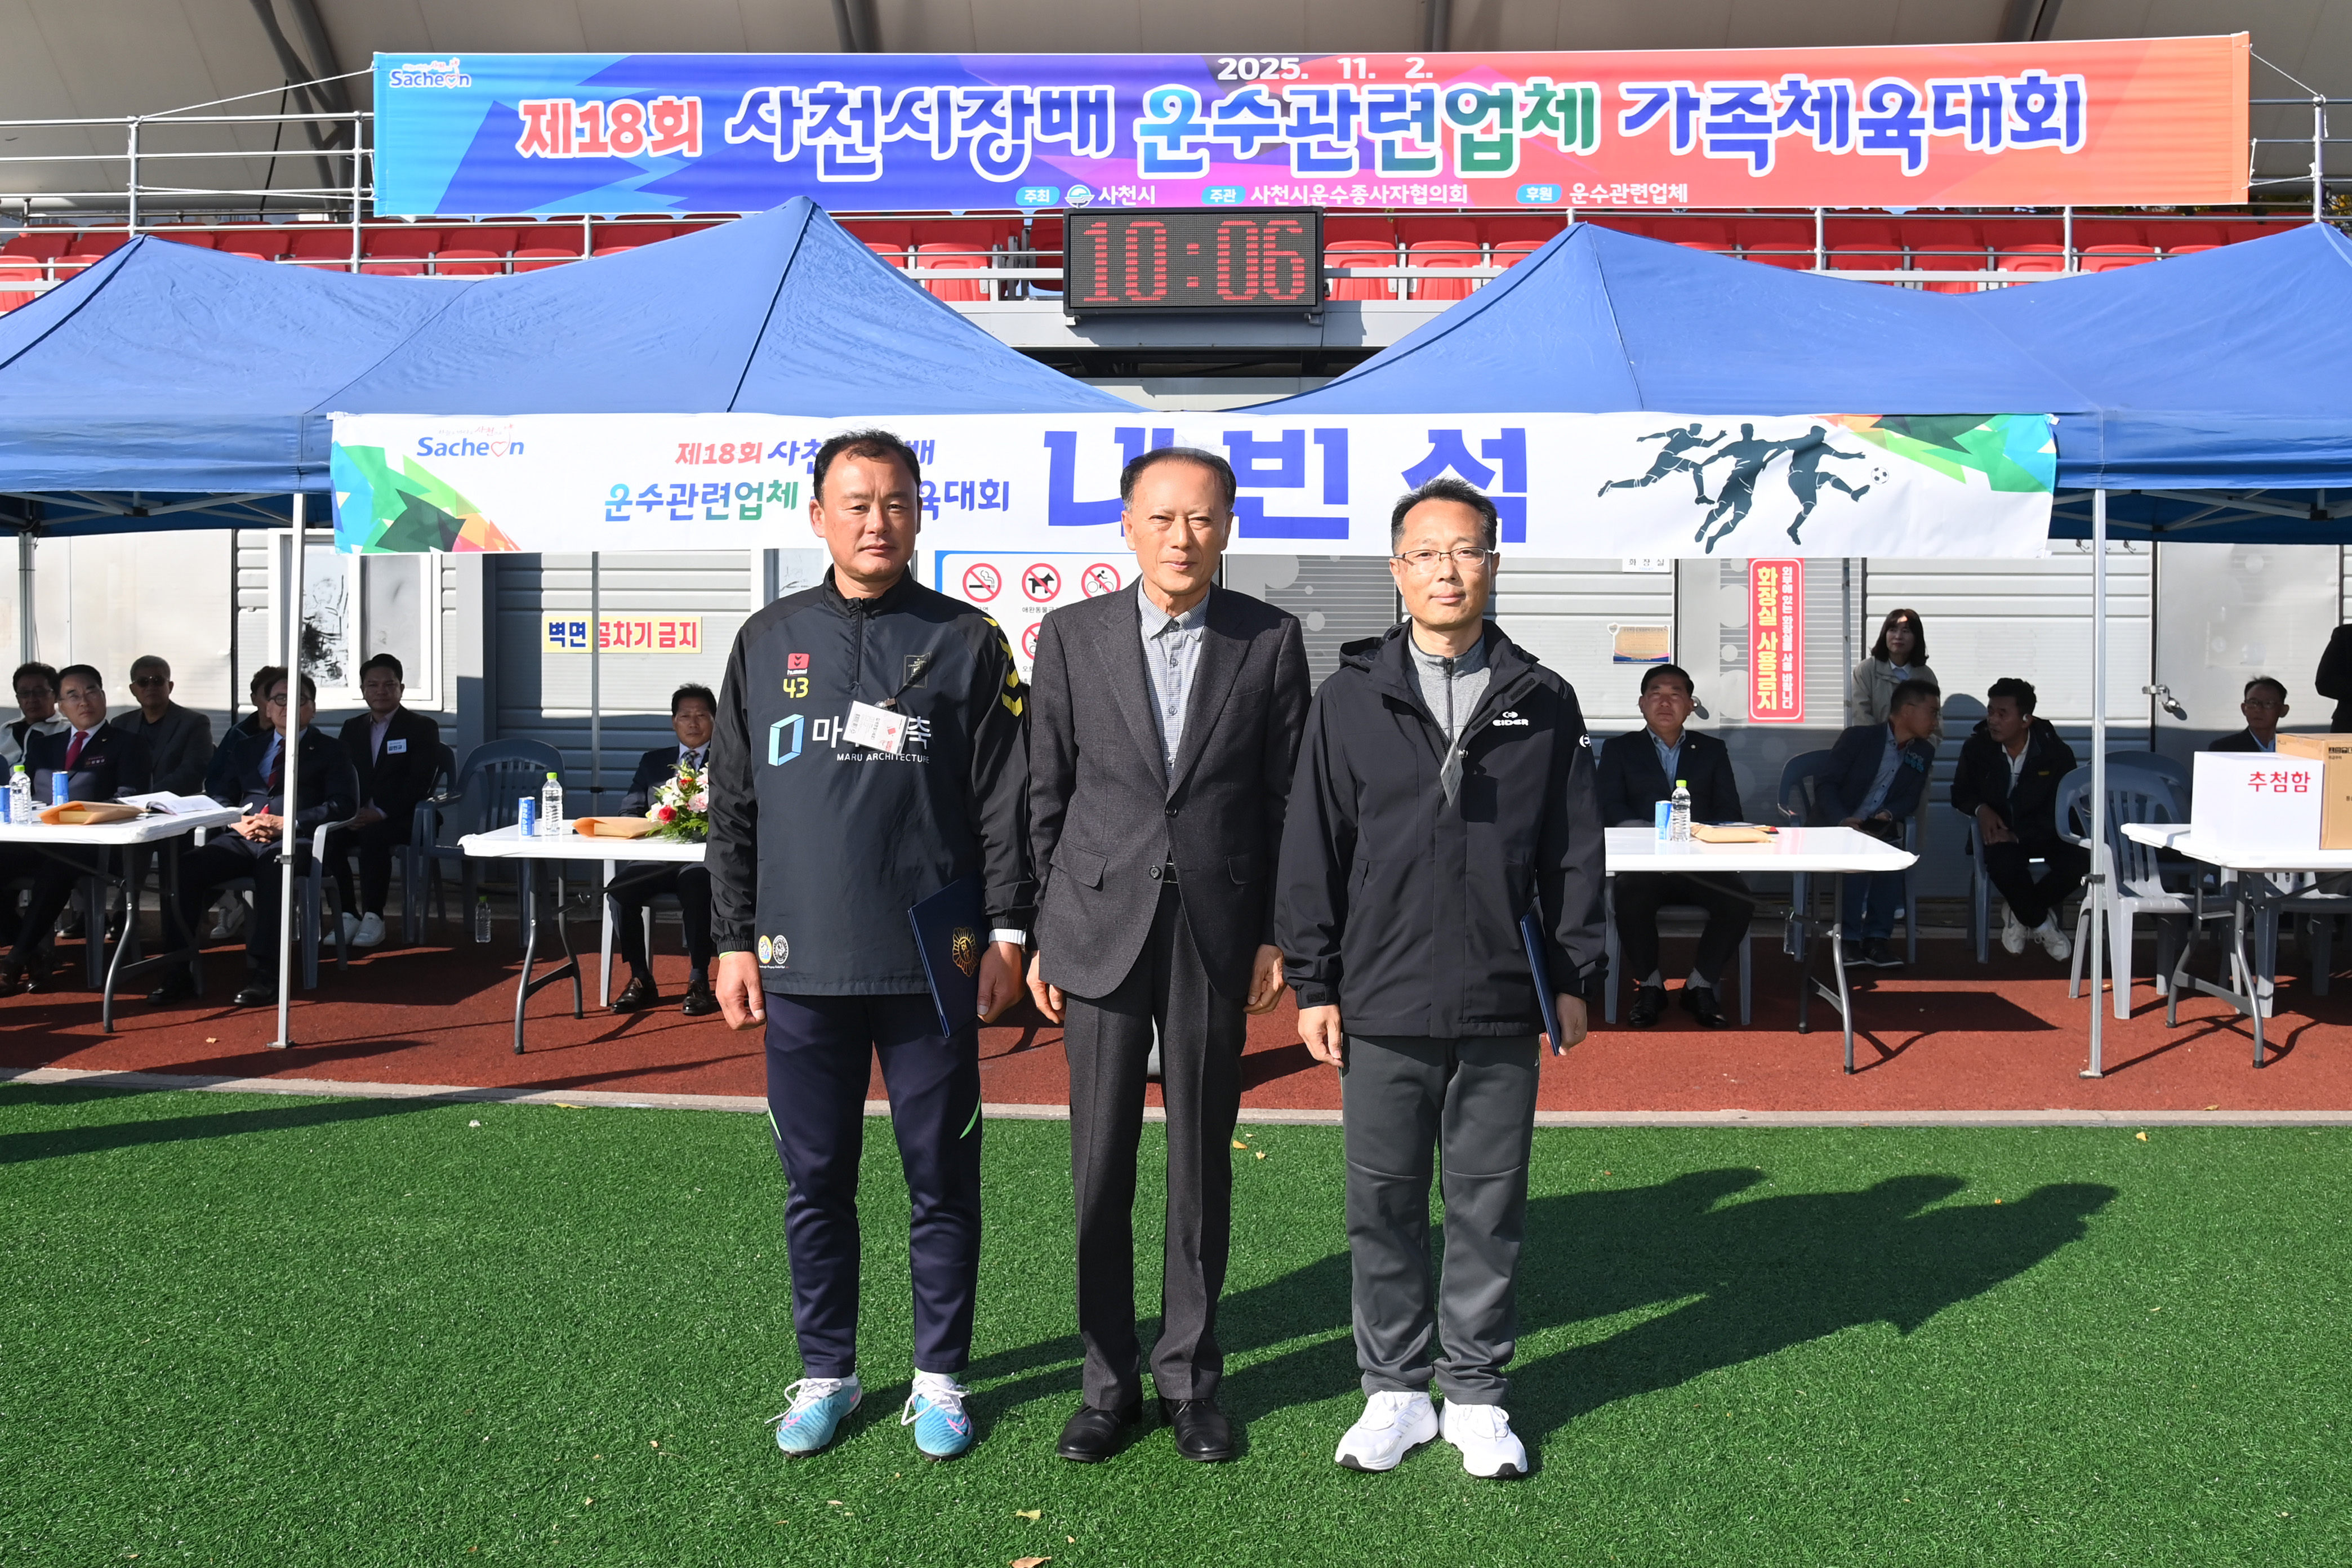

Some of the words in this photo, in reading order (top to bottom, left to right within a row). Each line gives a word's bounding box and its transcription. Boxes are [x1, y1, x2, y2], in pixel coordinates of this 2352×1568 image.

[1217, 57, 1308, 80] 2025.
[1337, 57, 1376, 79] 11.
[1405, 56, 1433, 78] 2.
[518, 97, 702, 158] 제18회
[726, 83, 1115, 181] 사천시장배
[1134, 77, 1600, 178] 운수관련업체
[1619, 69, 2087, 177] 가족체육대회
[1024, 189, 1050, 203] 주최
[1098, 185, 1156, 206] 사천시
[1210, 189, 1237, 203] 주관
[1250, 184, 1468, 206] 사천시운수종사자협의회
[1526, 186, 1553, 201] 후원
[1569, 182, 1688, 204] 운수관련업체
[1084, 220, 1306, 301] 10:06
[675, 442, 763, 466] 제18회
[604, 479, 799, 522] 운수관련업체
[1757, 567, 1778, 626] 화장실
[1782, 595, 1793, 614] 있는
[549, 622, 586, 648] 벽면
[599, 621, 652, 648] 공차기
[658, 622, 697, 648] 금지
[1757, 631, 1778, 710] 사용금지
[783, 677, 809, 698] 43
[1782, 673, 1793, 709] 바랍니다
[2248, 771, 2311, 792] 추첨함
